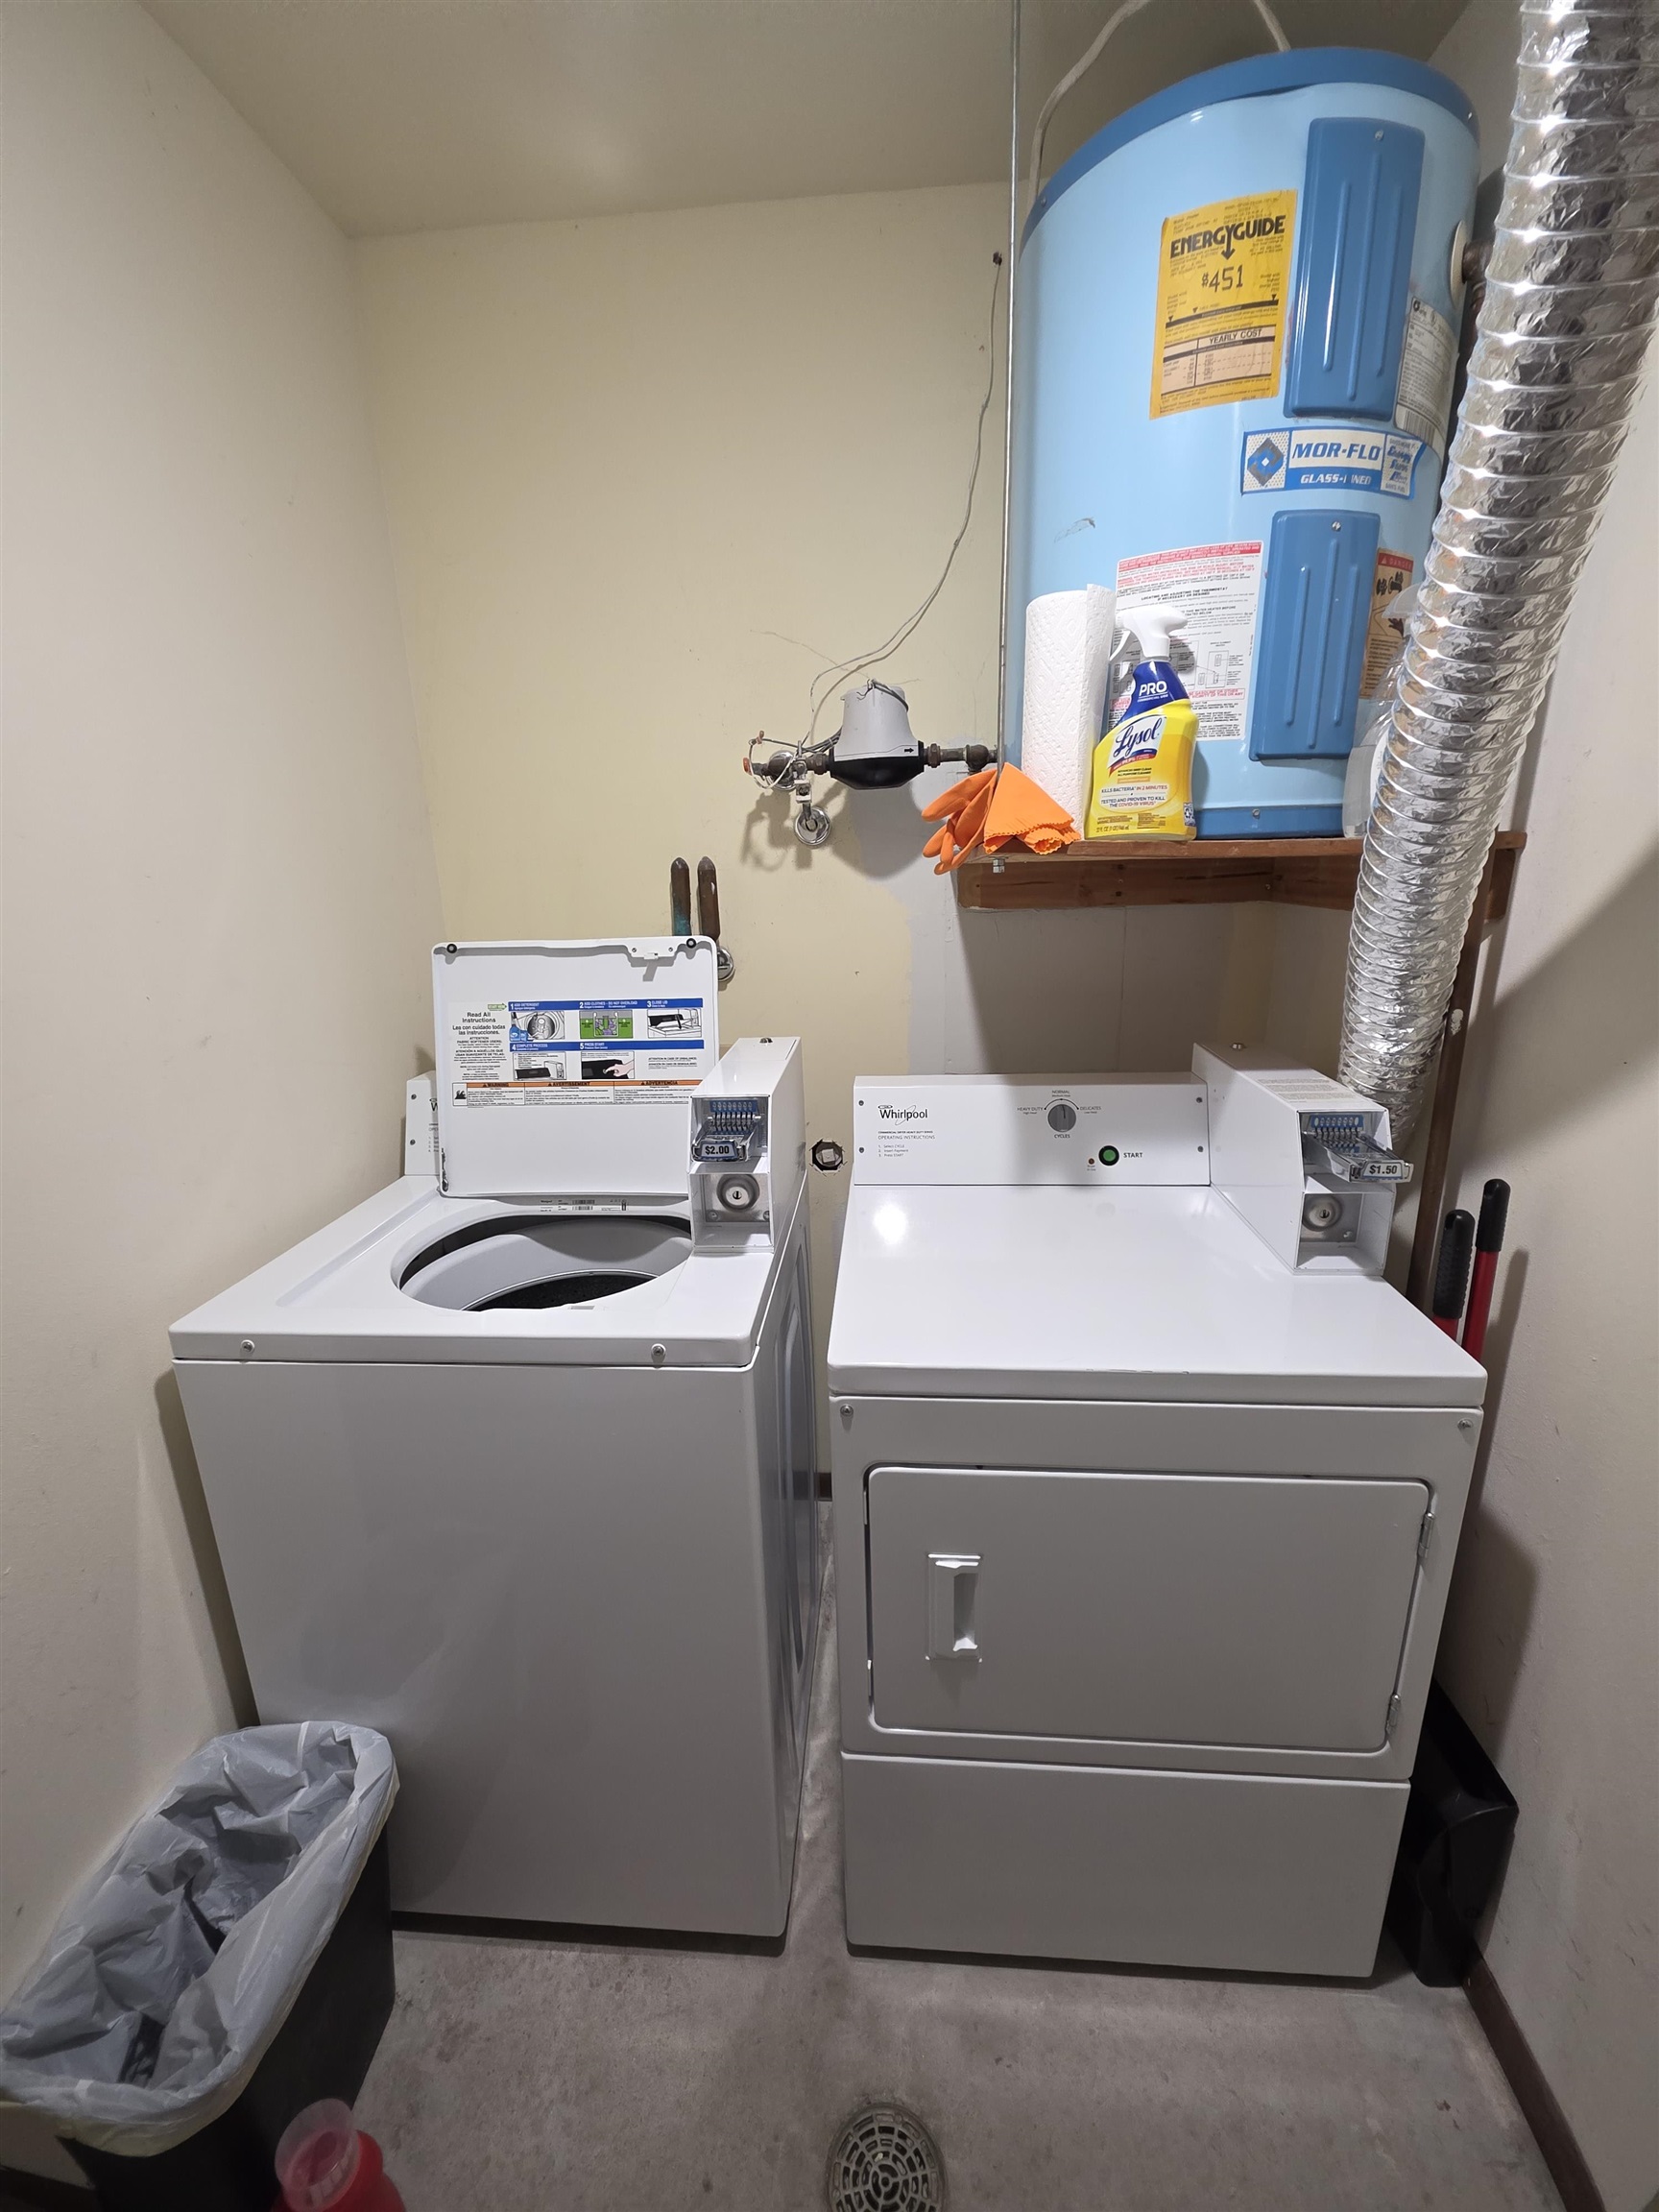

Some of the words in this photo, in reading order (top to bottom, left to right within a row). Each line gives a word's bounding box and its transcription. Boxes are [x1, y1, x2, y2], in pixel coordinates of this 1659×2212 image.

[1170, 215, 1286, 260] ENERGYGUIDE
[1202, 265, 1243, 292] $451
[1210, 333, 1237, 345] YEARLY
[1240, 328, 1262, 339] COST
[1292, 443, 1382, 461] MOR-FLO
[1139, 681, 1167, 696] PRO
[1114, 717, 1163, 757] Lysol
[879, 1108, 928, 1121] Whirlpool
[705, 1145, 730, 1155] $2.00
[1369, 1165, 1398, 1175] $1.50
